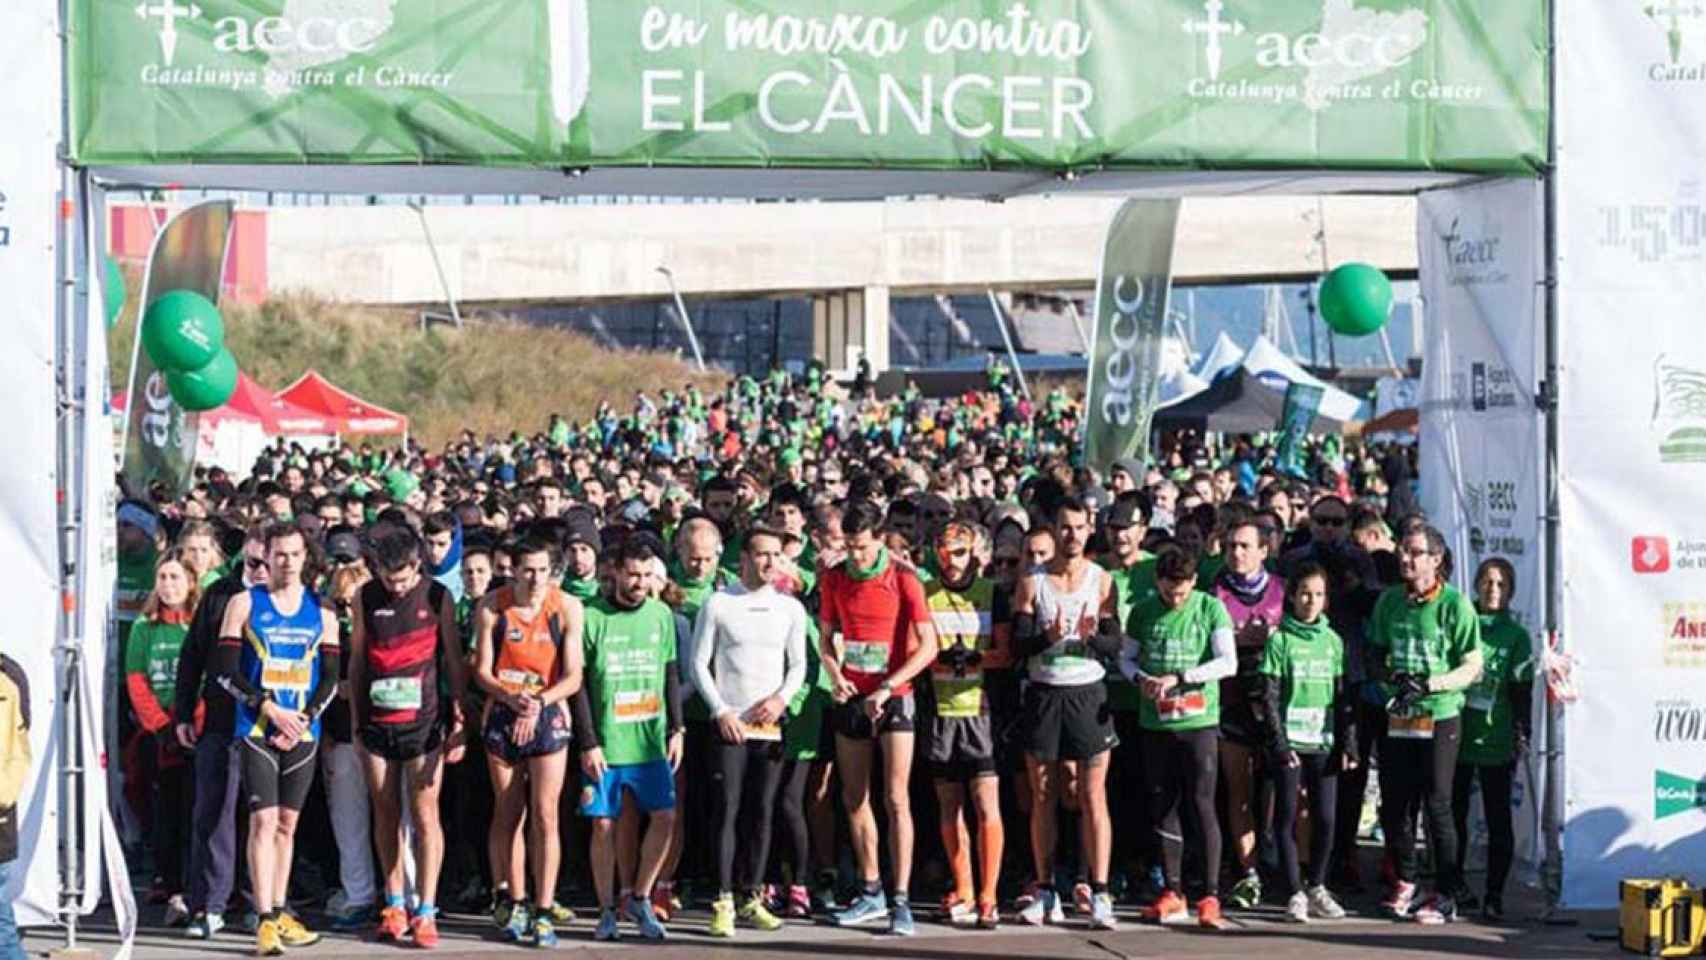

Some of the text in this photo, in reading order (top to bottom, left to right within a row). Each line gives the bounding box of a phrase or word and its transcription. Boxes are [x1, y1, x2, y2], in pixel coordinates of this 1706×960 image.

[213, 15, 377, 53] aecc
[640, 2, 1093, 57] en marxa contra
[1255, 32, 1411, 67] aecc
[141, 64, 257, 90] Catalunya
[345, 66, 363, 86] el
[374, 66, 453, 87] Càncer
[1187, 78, 1296, 102] Catalunya
[1382, 80, 1401, 98] el
[1410, 79, 1483, 99] Càncer
[642, 57, 1095, 139] EL CÀNCER
[1102, 275, 1143, 426] aecc
